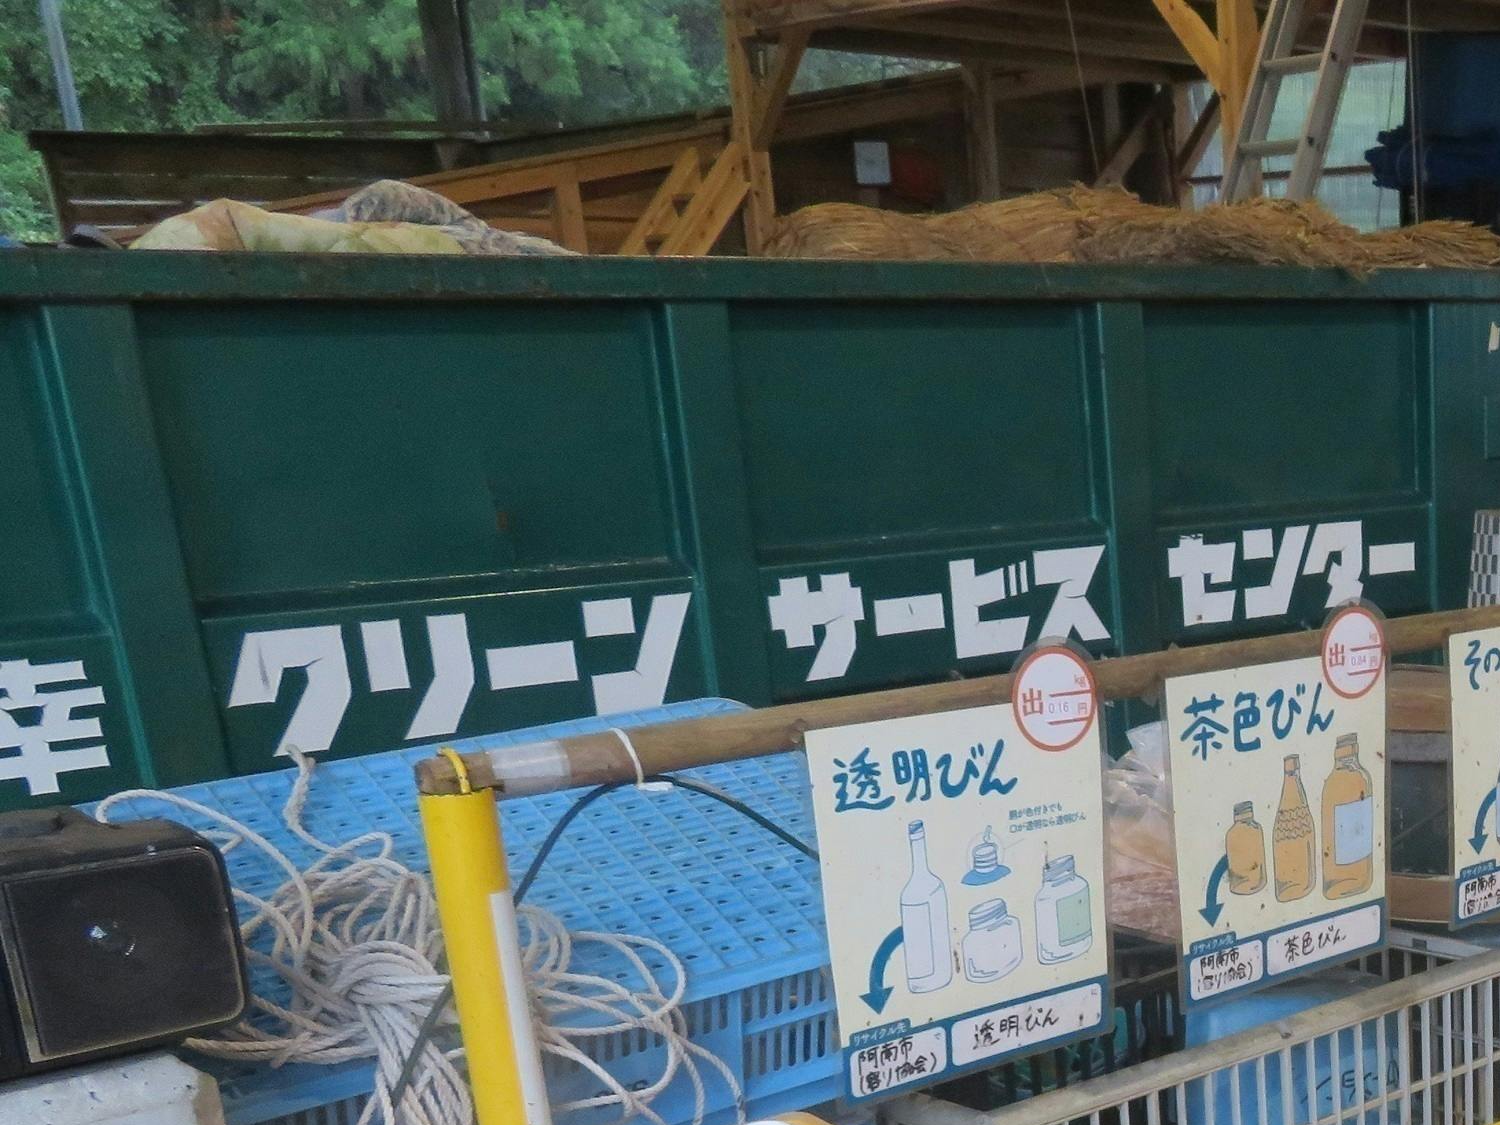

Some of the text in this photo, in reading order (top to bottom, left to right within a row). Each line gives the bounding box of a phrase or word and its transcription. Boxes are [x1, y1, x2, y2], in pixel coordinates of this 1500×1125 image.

[228, 592, 692, 757] クリーン
[768, 545, 1111, 682] サービス
[1167, 520, 1415, 627] センター
[1329, 643, 1345, 667] 出
[1022, 688, 1043, 717] 出
[1180, 682, 1335, 761] 茶色びん
[832, 738, 1018, 813] 透明びん
